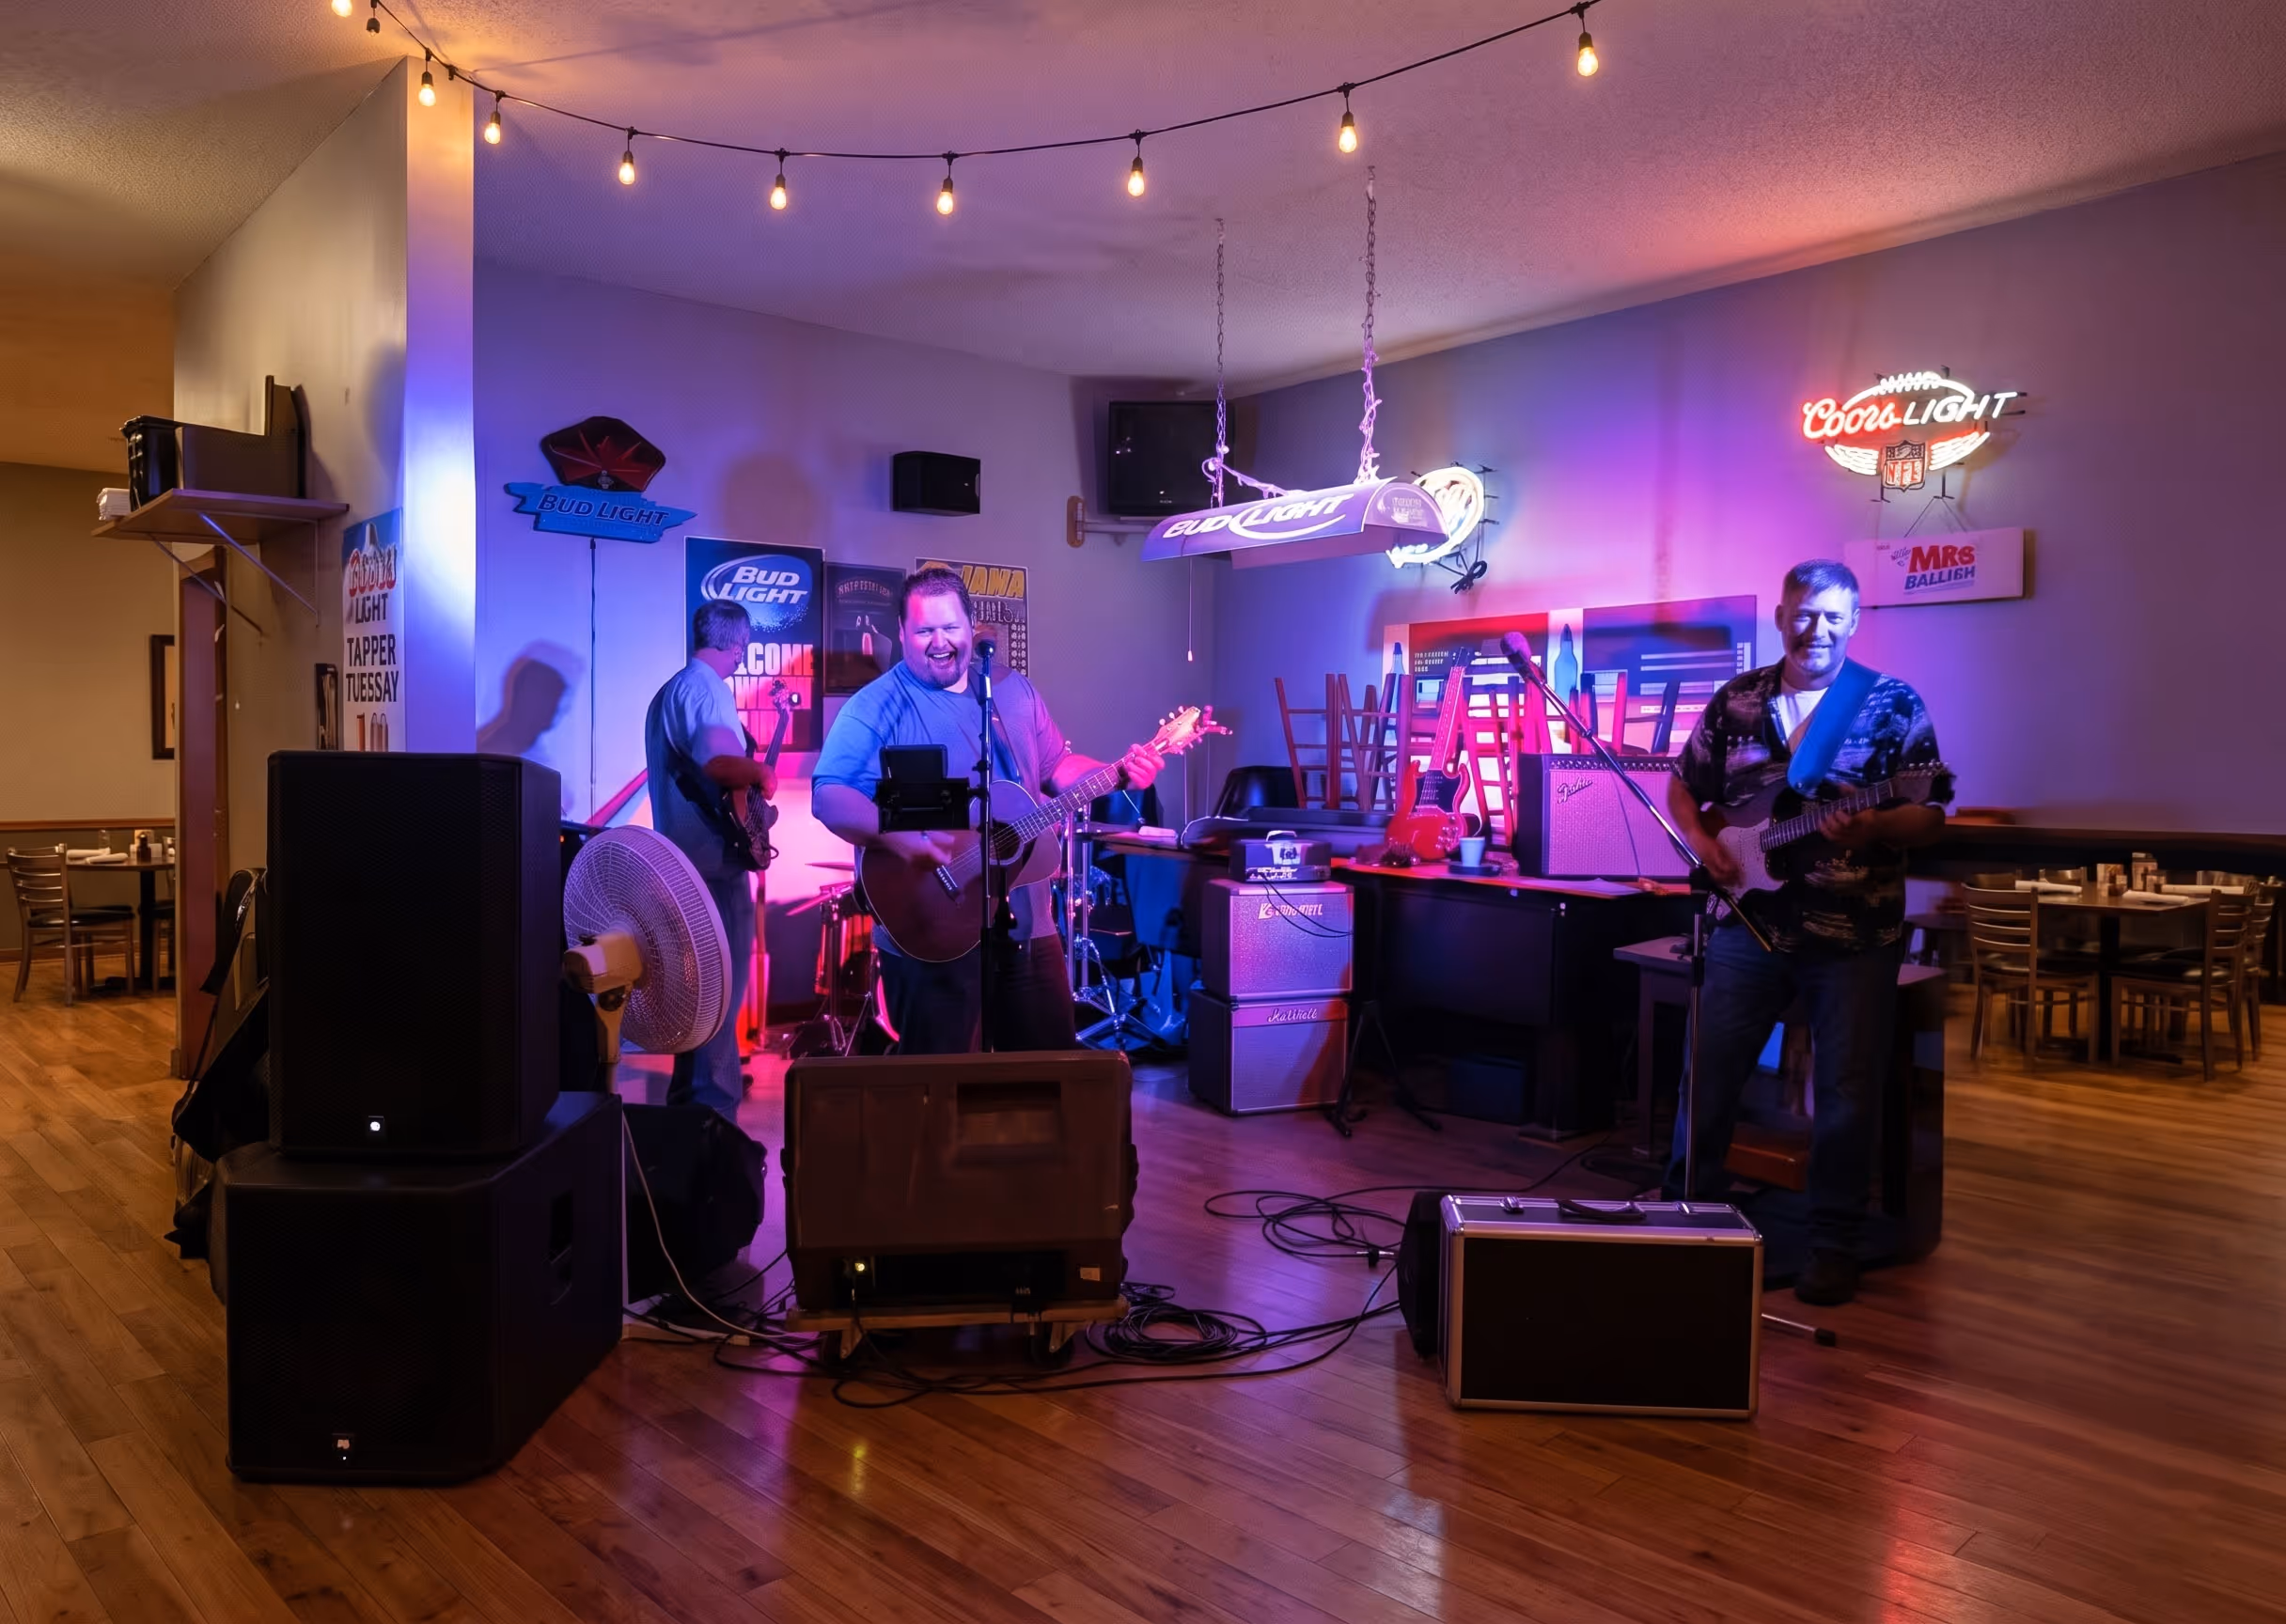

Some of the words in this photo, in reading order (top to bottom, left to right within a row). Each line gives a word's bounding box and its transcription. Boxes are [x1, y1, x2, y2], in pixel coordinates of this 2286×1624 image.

[1902, 392, 2018, 425] LIGHT
[538, 493, 594, 517] BUD
[596, 502, 669, 526] LIGHT
[1163, 515, 1234, 539] BUD
[1241, 493, 1354, 527] LIGHT
[732, 566, 800, 586] BUD
[720, 583, 808, 605] LIGHT
[347, 633, 397, 667] TAPPER
